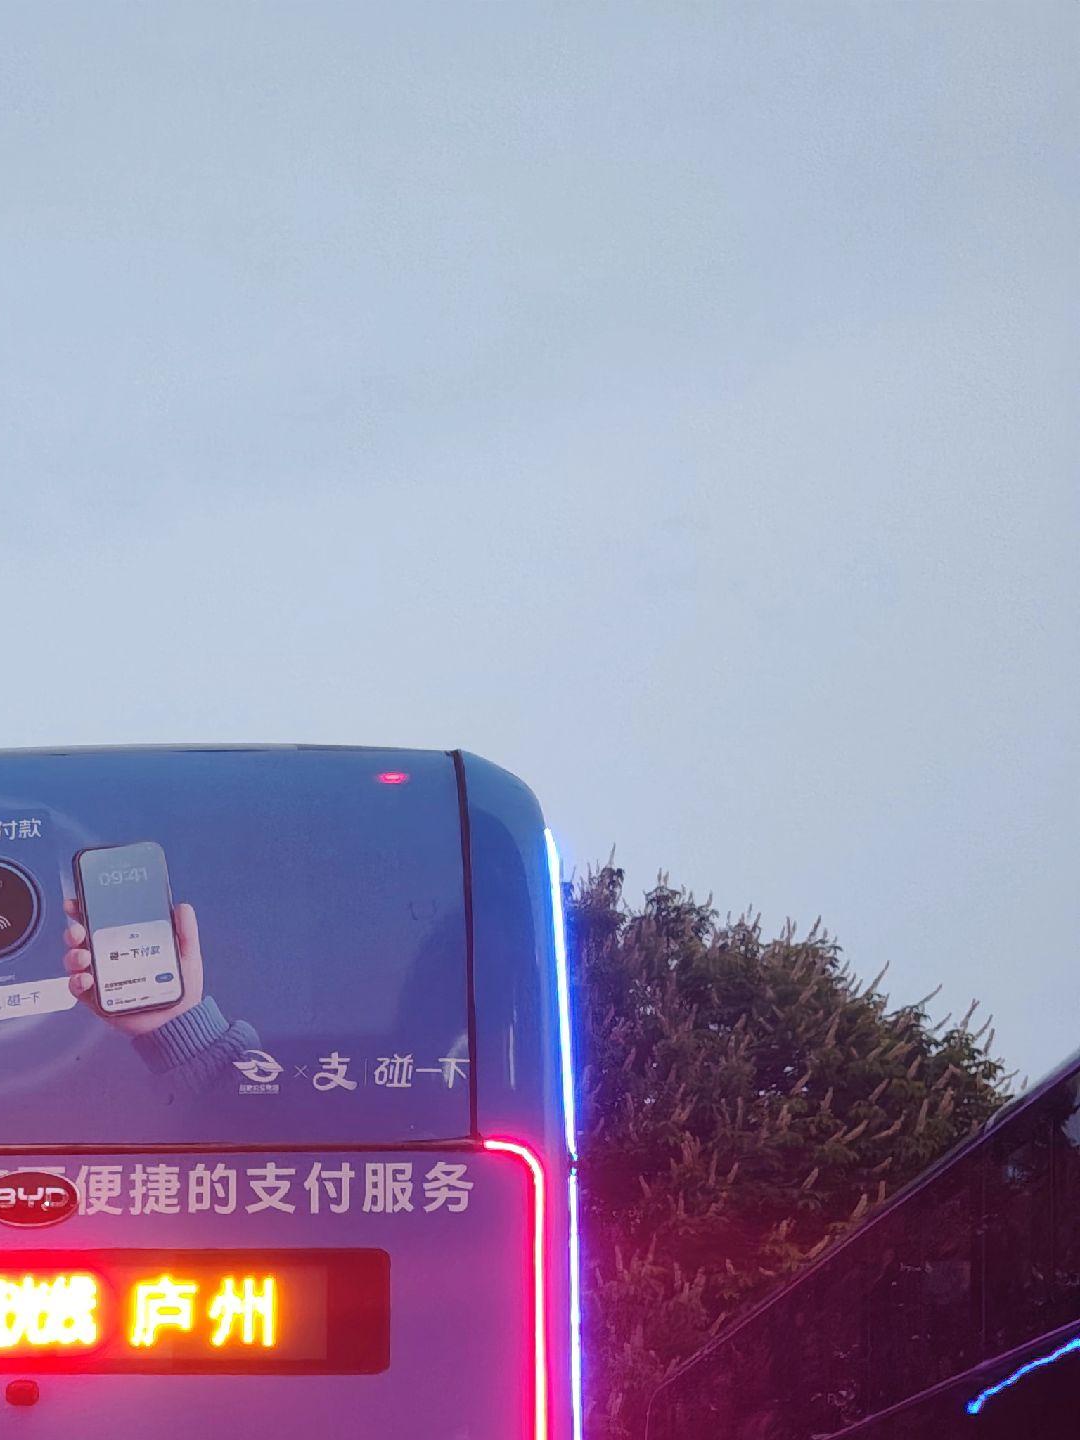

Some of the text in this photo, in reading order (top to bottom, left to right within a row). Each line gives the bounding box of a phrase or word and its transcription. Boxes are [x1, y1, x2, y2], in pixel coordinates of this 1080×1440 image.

[373, 1053, 470, 1089] 碰一下
[130, 1276, 276, 1348] 庐州
